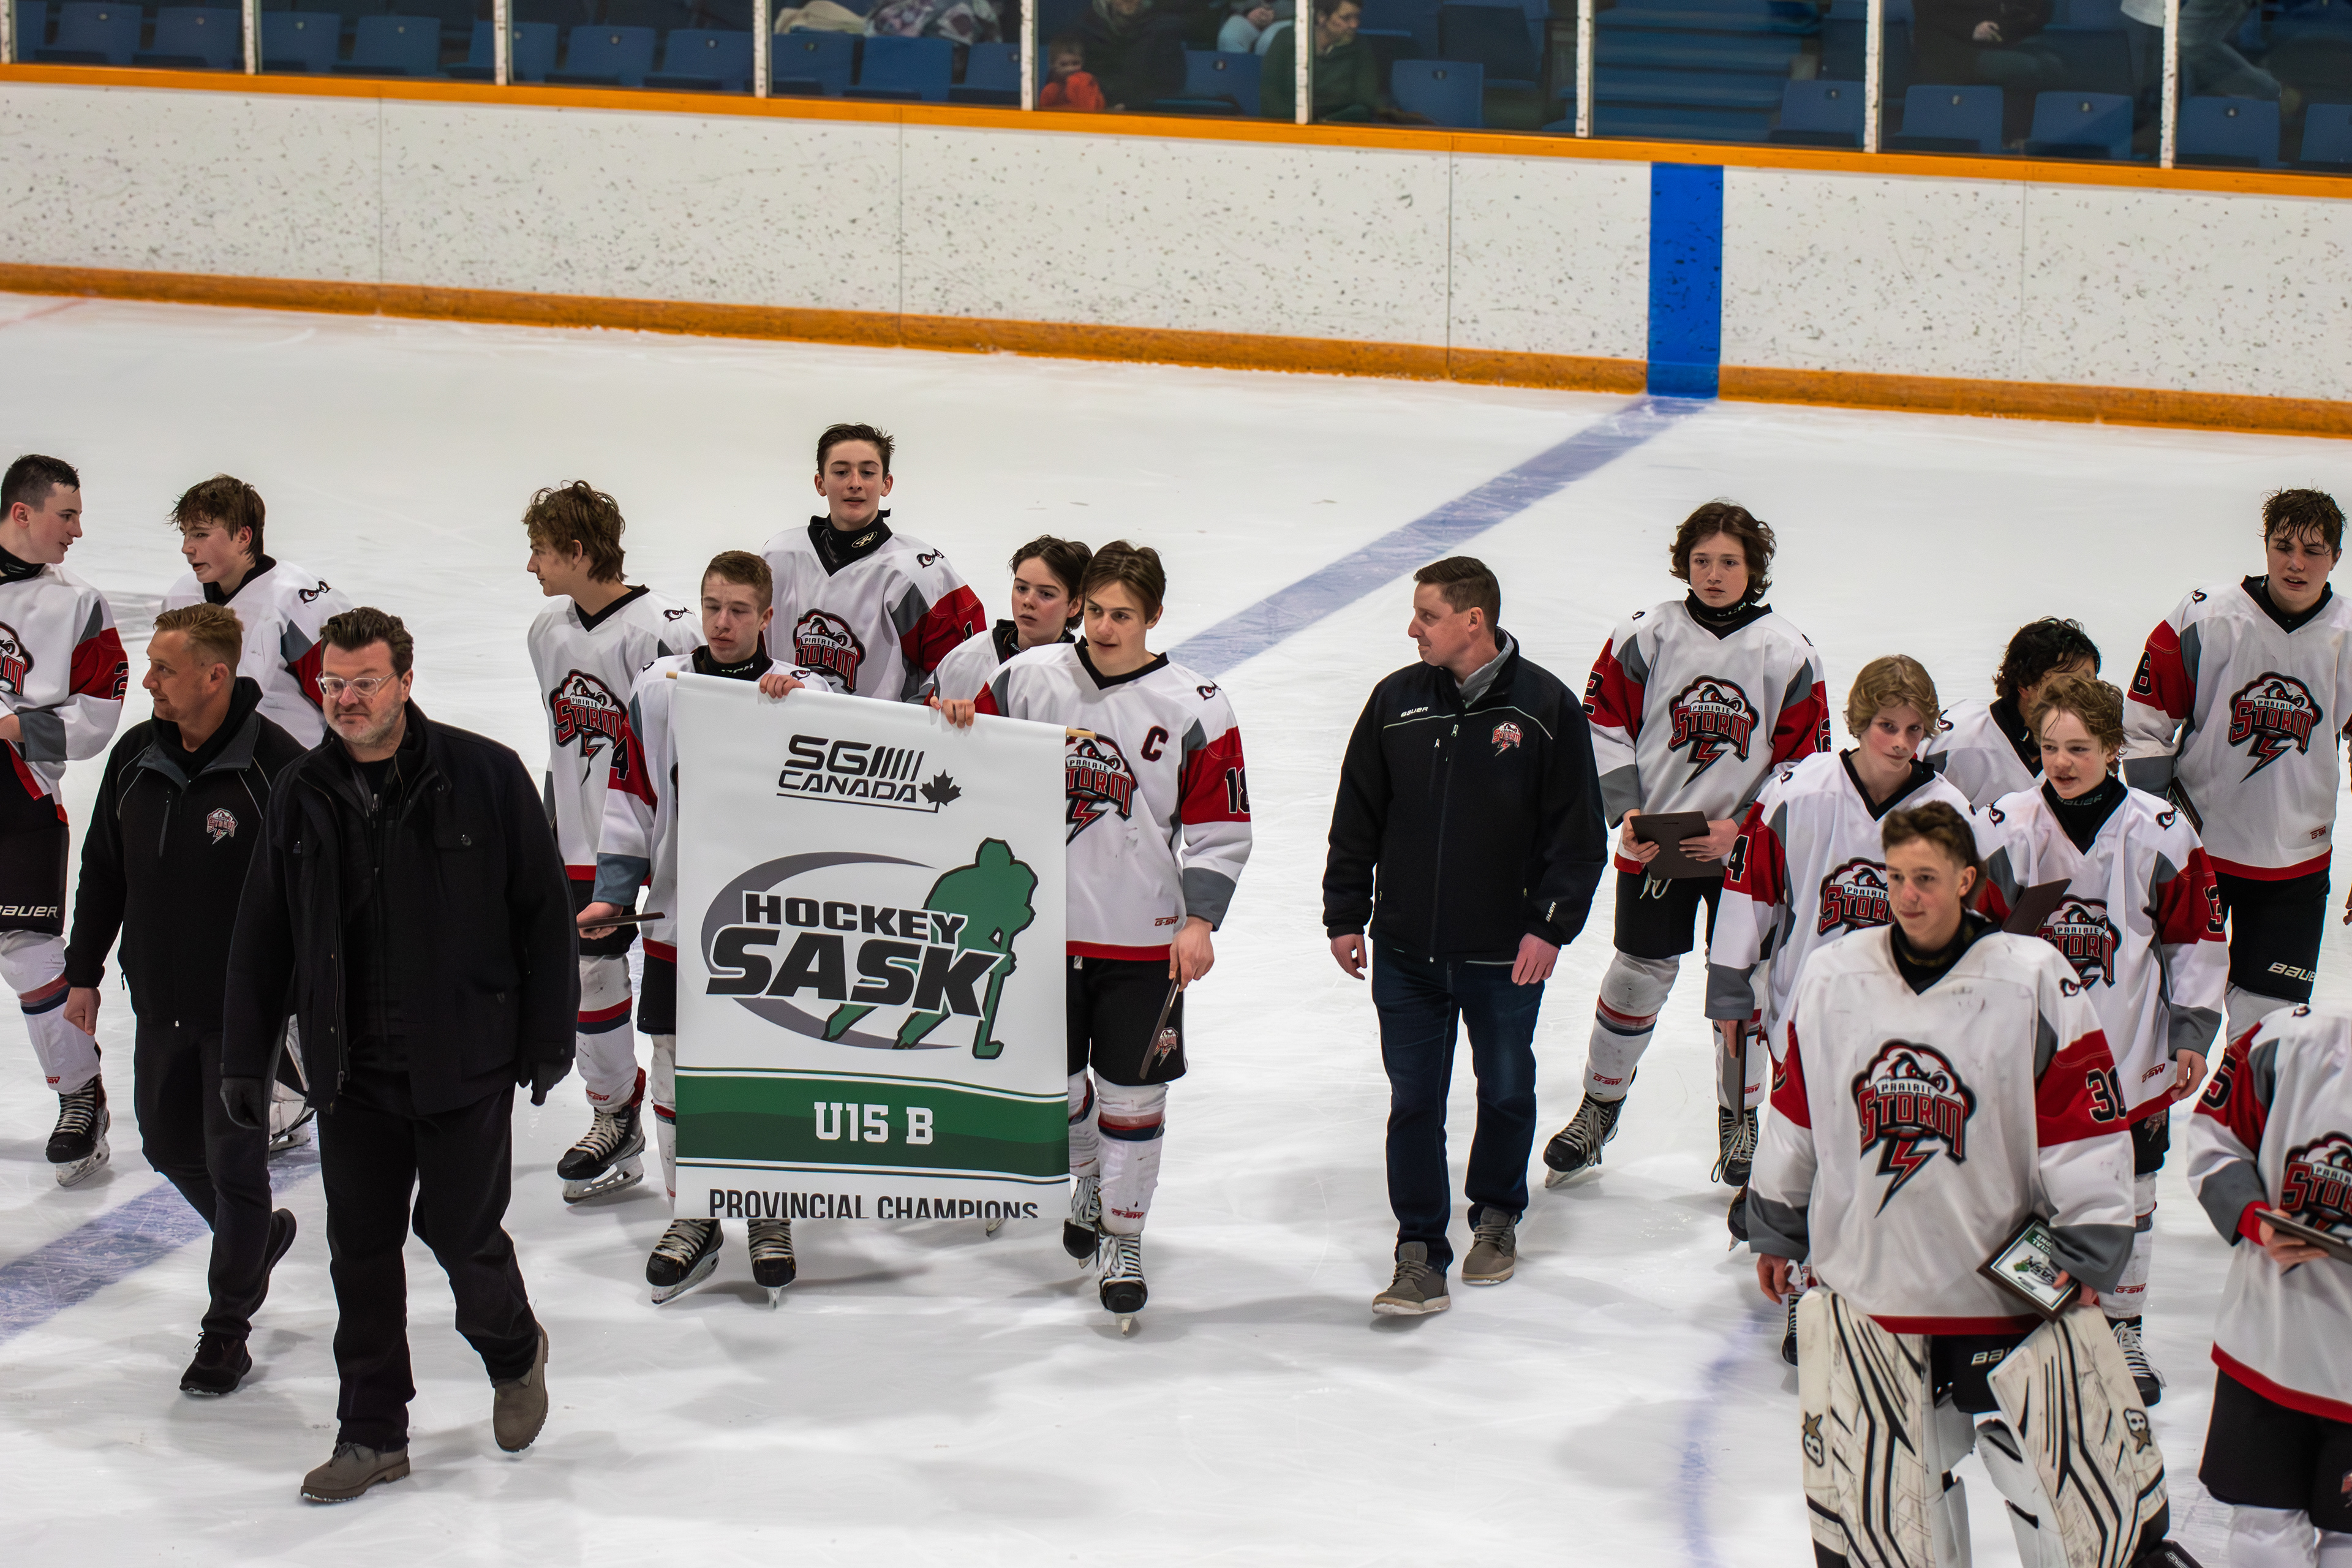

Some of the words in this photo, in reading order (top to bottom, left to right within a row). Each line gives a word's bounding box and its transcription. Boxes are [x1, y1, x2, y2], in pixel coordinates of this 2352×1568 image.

[1692, 704, 1731, 714] PRAIRIE
[2231, 701, 2313, 750] STORM
[1141, 725, 1169, 761] C
[1670, 706, 1751, 758] STORM
[610, 736, 630, 780] 4
[1069, 759, 1109, 772] PRAIRIE
[778, 769, 916, 803] CANADA
[1066, 766, 1132, 816] TORM
[1727, 834, 1750, 883] 4
[0, 905, 58, 919] AUER
[745, 892, 966, 944] HOCKEY
[1545, 901, 1556, 923] AUER
[1820, 885, 1894, 932] STOR
[2057, 925, 2100, 935] PRAIRIE
[706, 926, 1001, 1017] SASK
[814, 1102, 889, 1143] U15
[907, 1106, 933, 1145] B
[1858, 1084, 1962, 1158] STORM
[709, 1188, 870, 1219] PROVINCIAL
[877, 1195, 1039, 1219] CHAMPIONS
